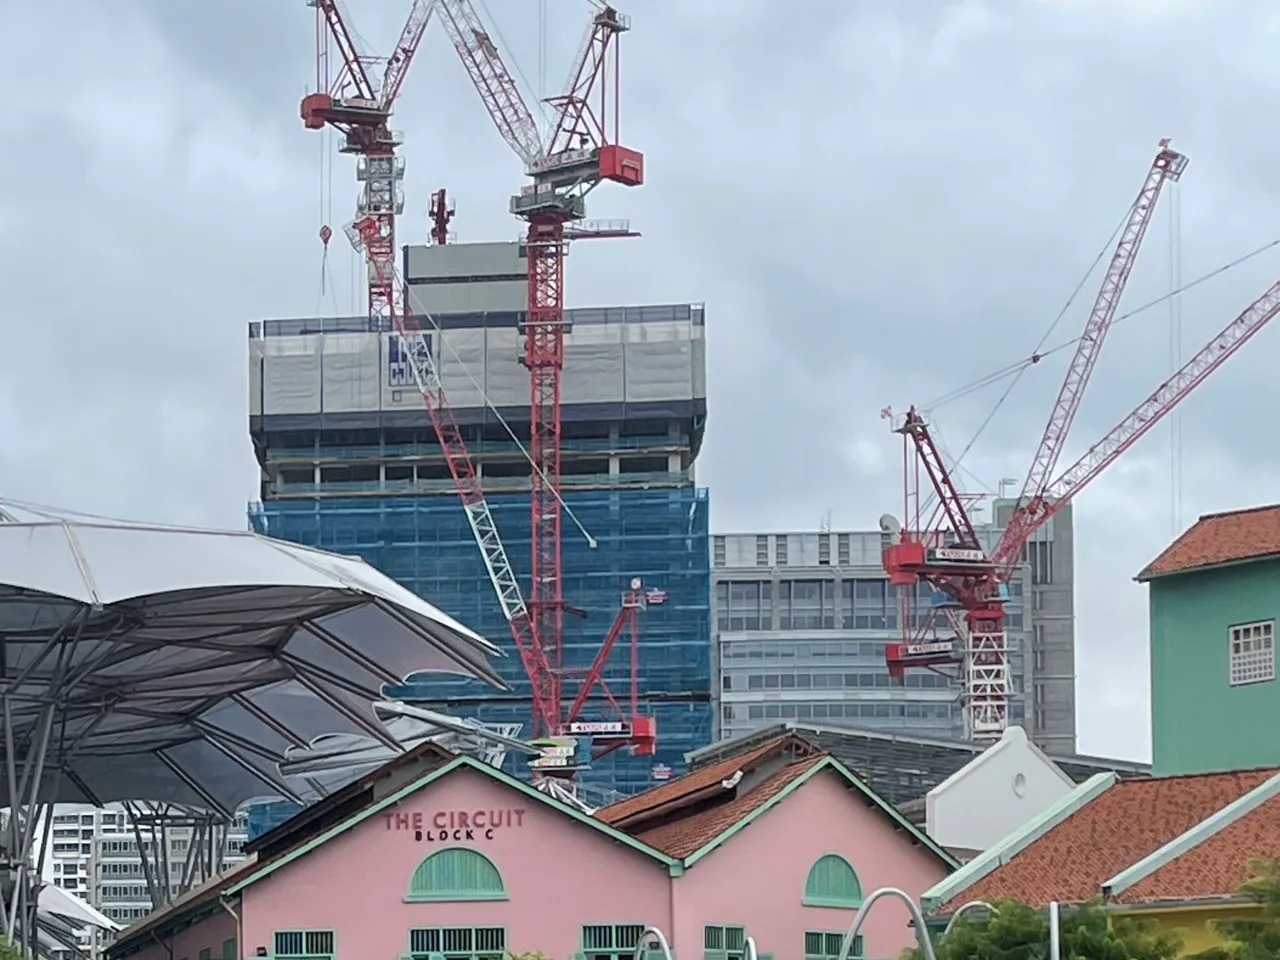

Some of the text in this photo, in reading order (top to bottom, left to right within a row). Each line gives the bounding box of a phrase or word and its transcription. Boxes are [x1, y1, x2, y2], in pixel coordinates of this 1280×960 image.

[383, 808, 526, 830] THE CIRCUIT
[414, 828, 494, 841] BLOCK C
